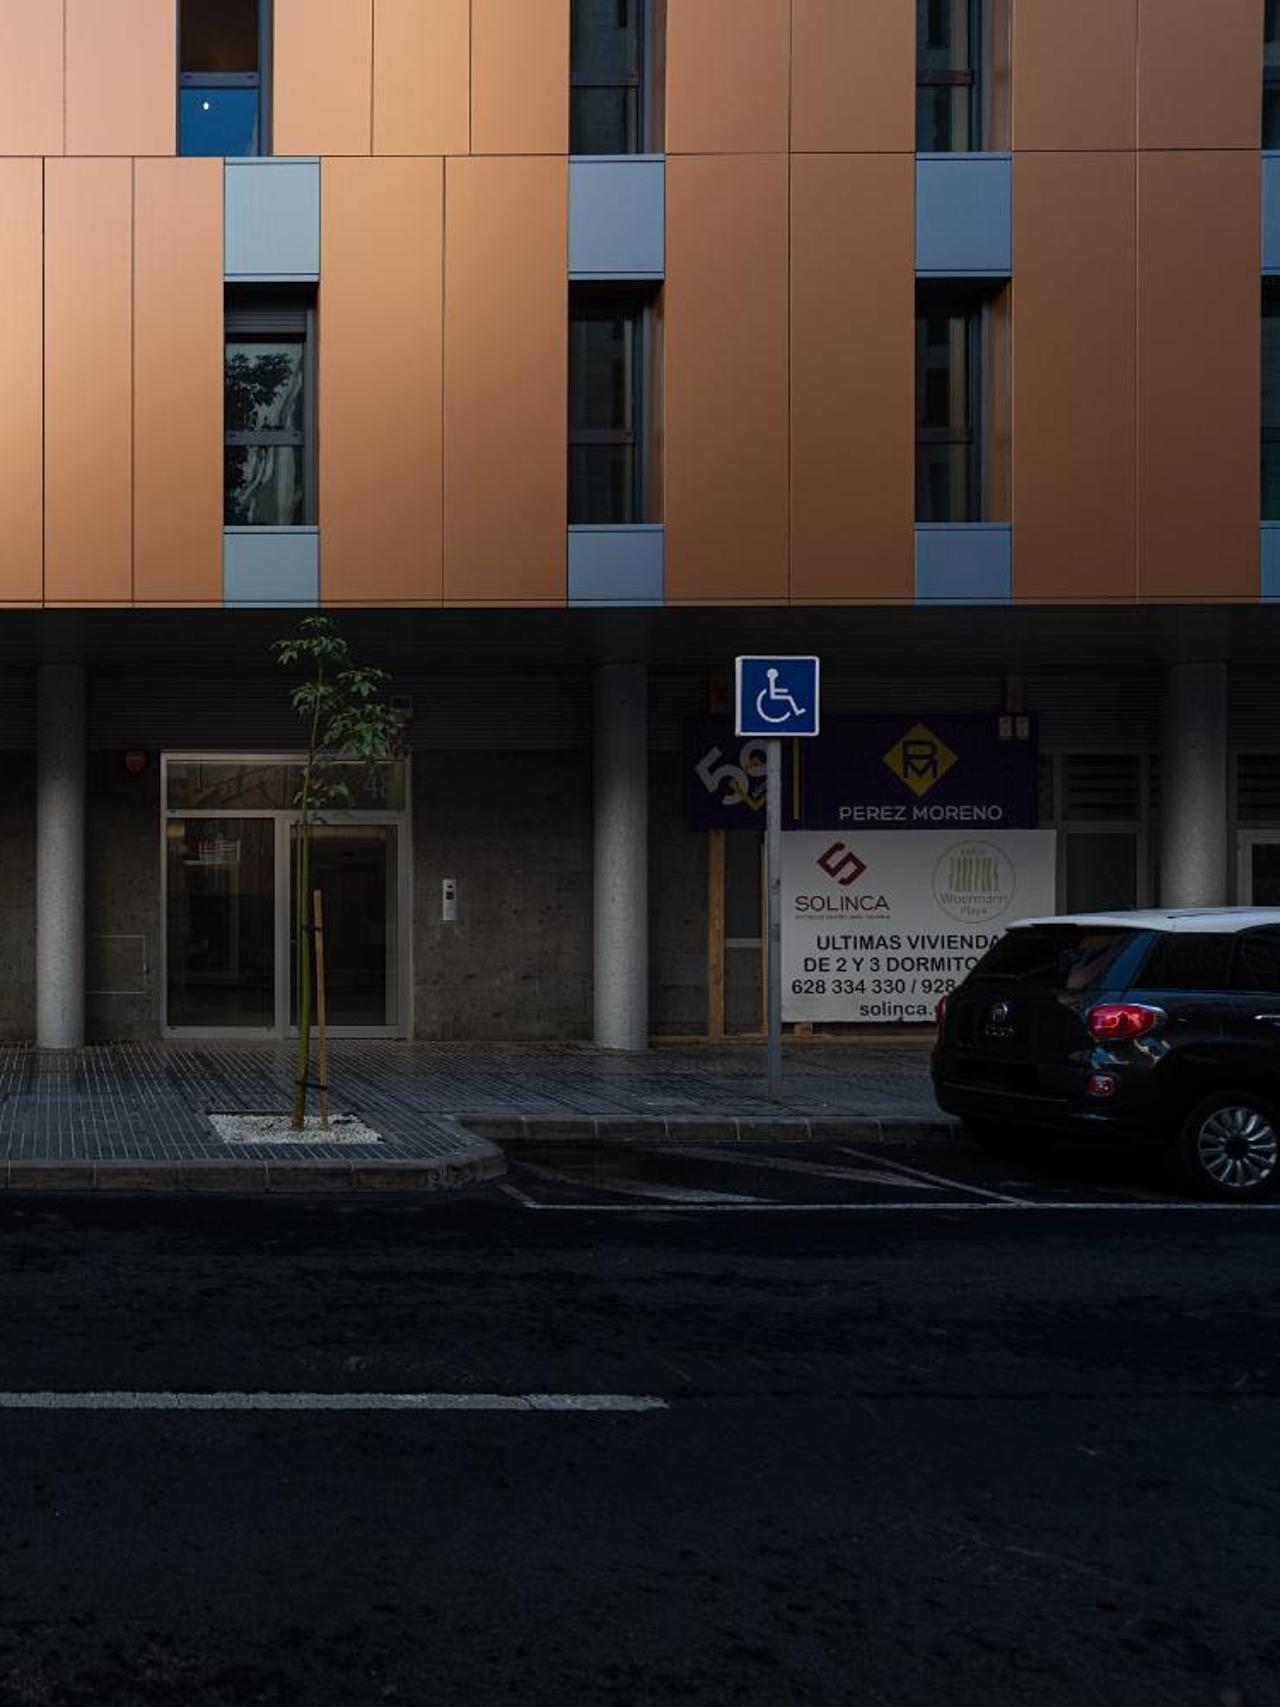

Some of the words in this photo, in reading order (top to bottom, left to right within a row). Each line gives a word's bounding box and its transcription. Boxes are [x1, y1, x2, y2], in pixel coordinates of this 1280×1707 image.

[839, 806, 907, 821] PEREZ
[913, 805, 1003, 821] MORENO
[795, 896, 890, 912] SOLINCA
[816, 935, 901, 950] ULTIMAS
[804, 957, 830, 972] DE
[836, 957, 847, 972] 2
[852, 957, 867, 972] Y
[870, 957, 881, 972] 3
[792, 979, 825, 994] 628
[831, 979, 865, 994] 334
[872, 979, 905, 994] 330
[921, 979, 955, 994] 928
